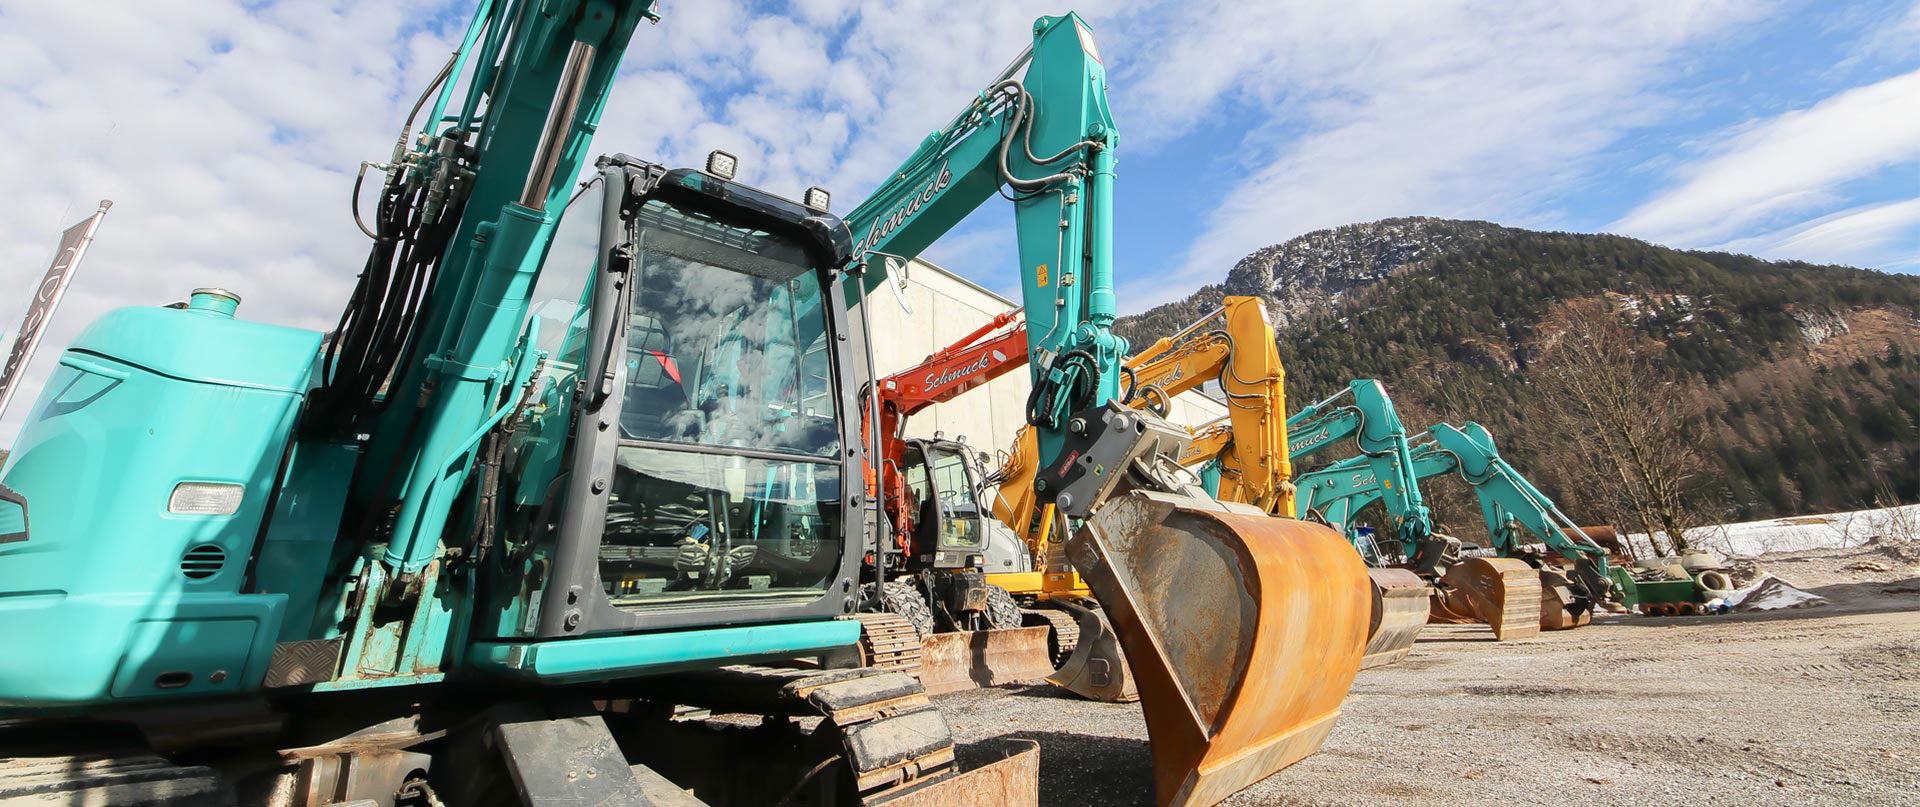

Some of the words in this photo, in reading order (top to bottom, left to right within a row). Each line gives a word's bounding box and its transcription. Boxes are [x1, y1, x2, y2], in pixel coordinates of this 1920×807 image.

[851, 157, 953, 263] chmuck
[924, 350, 990, 393] Schmuck
[1289, 425, 1331, 453] muck
[1351, 472, 1377, 488] Sch
